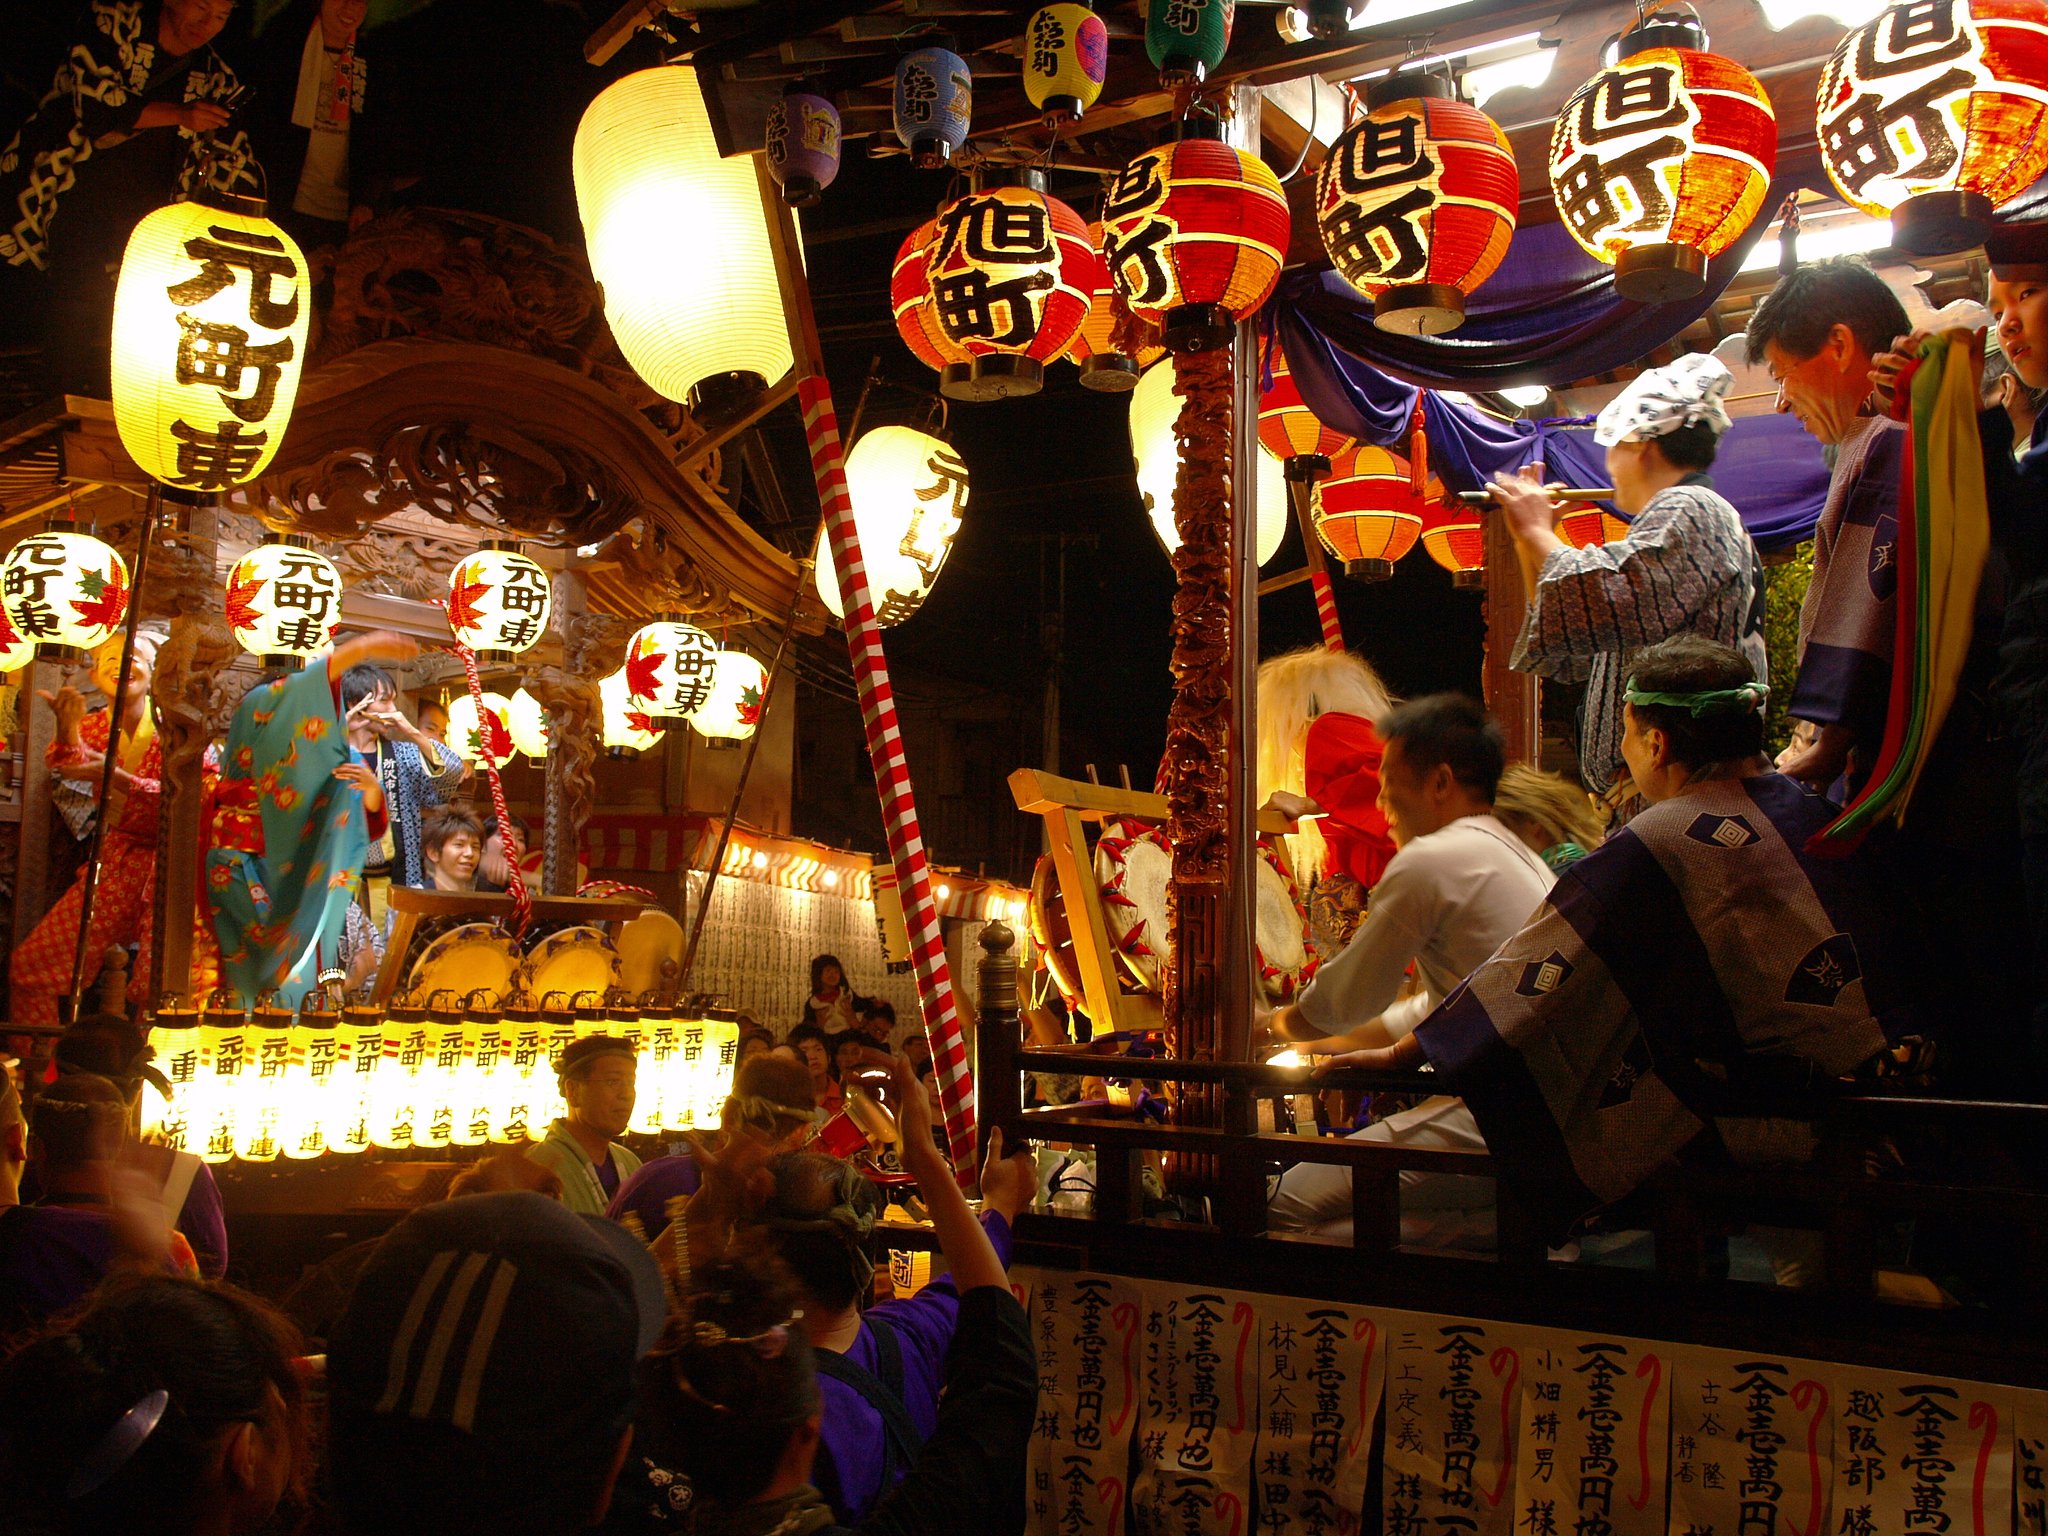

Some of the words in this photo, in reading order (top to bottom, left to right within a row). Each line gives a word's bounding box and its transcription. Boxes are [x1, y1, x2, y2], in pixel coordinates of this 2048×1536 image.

[1319, 115, 1435, 282] 旭町
[1550, 66, 1688, 244] 旭町
[928, 196, 1057, 347] 旭町
[160, 224, 297, 490] 元町東
[5, 536, 67, 638] 元町東
[273, 552, 335, 650] 元町東
[496, 558, 547, 647] 元町東
[664, 627, 718, 715] 元町東
[1894, 1384, 1960, 1536] 一金壱萬
